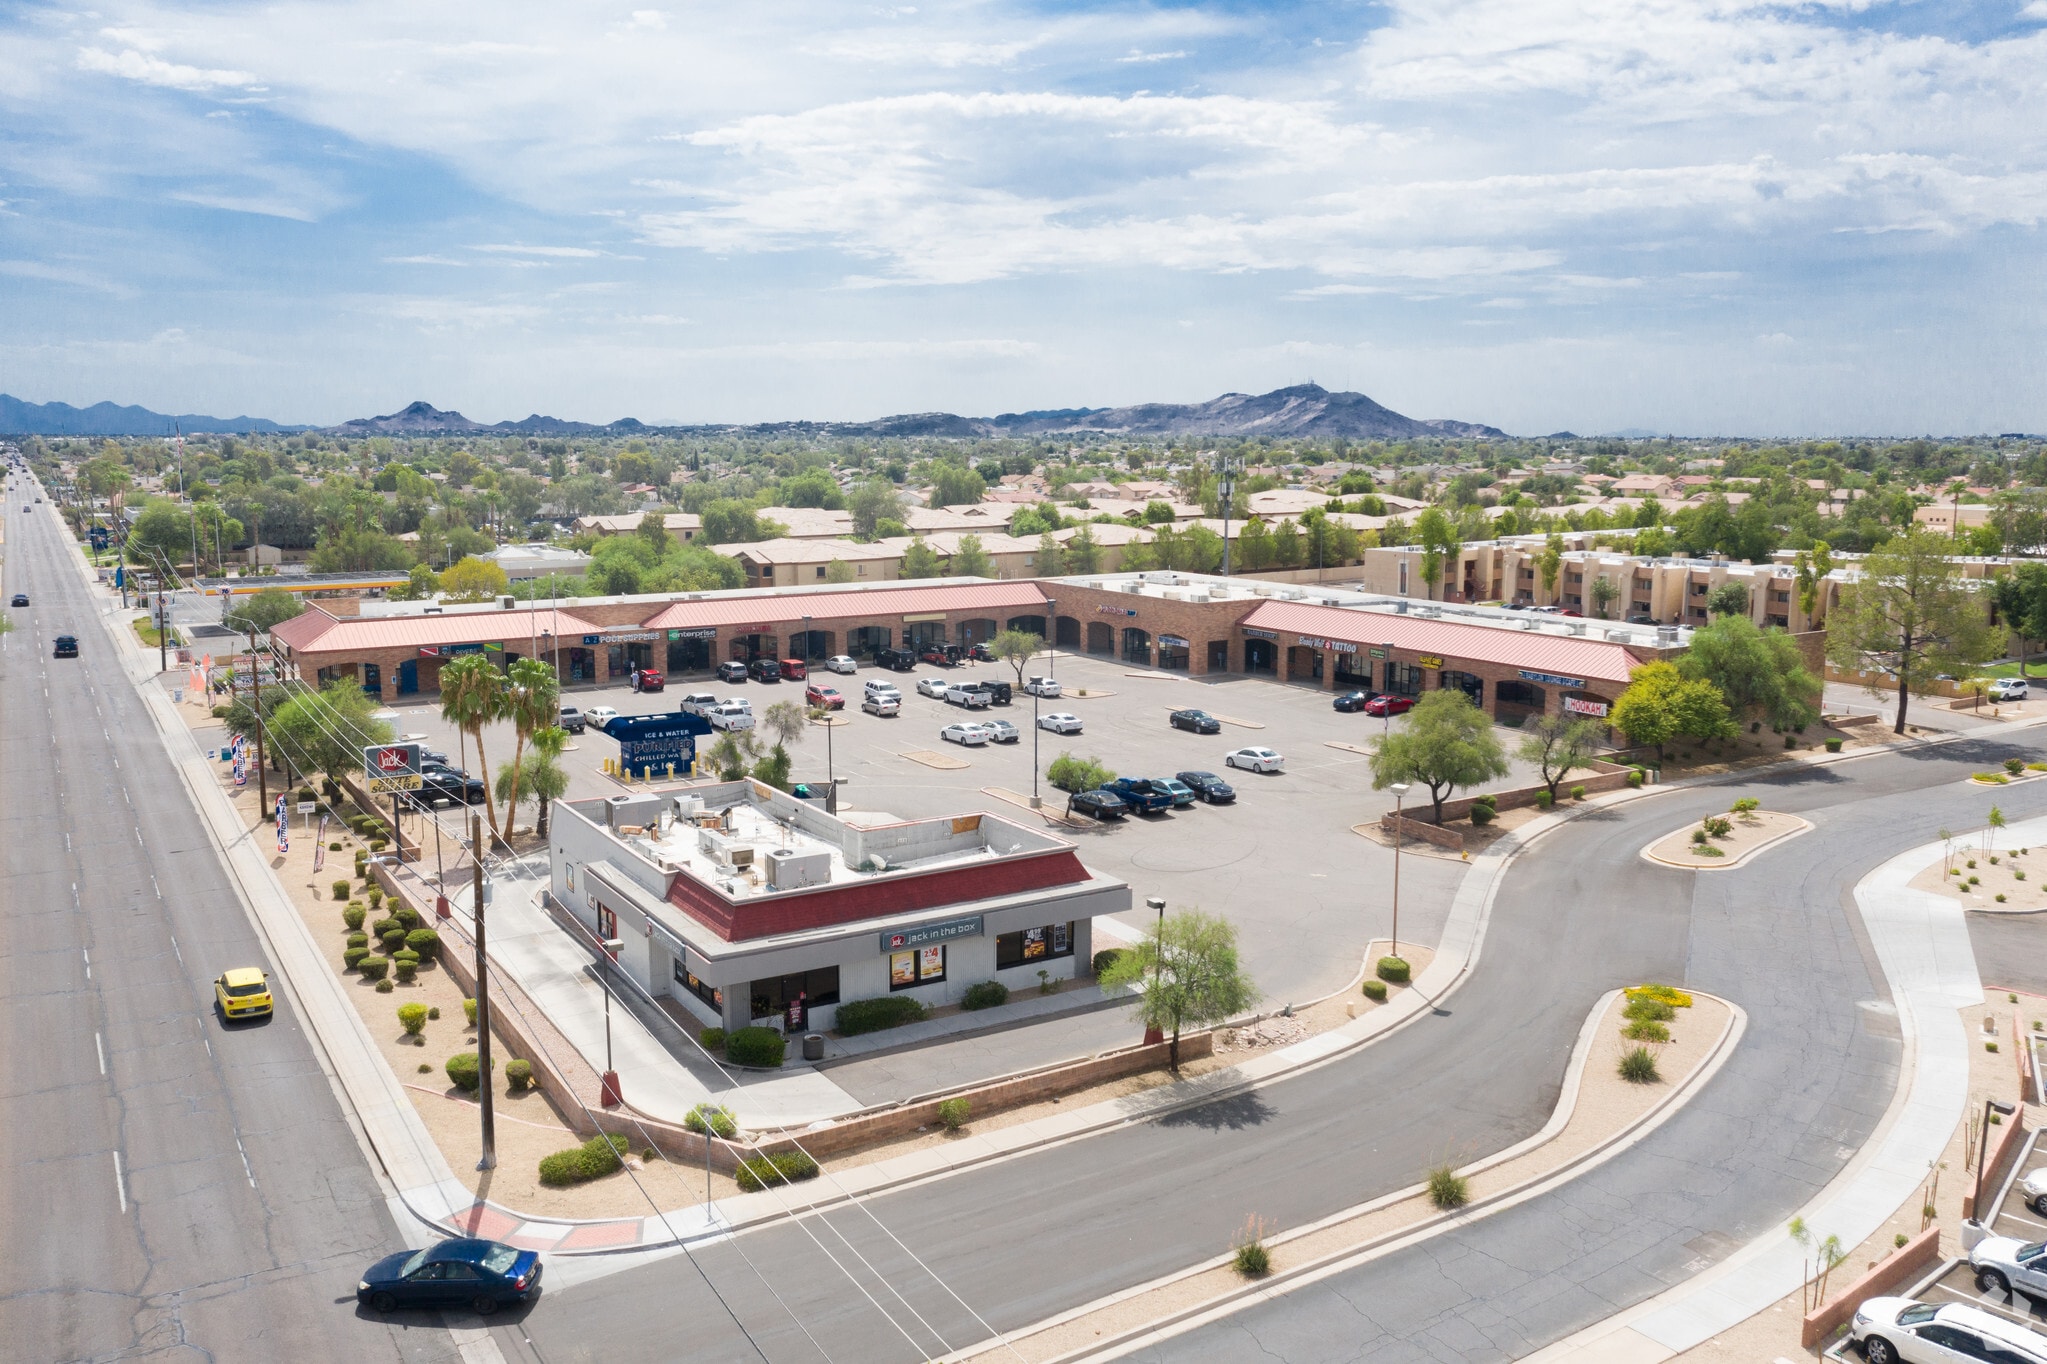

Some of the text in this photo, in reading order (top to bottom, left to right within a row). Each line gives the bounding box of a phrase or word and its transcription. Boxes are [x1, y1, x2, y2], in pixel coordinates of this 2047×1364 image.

[600, 633, 622, 643] POOL
[623, 632, 660, 641] SUPPLIES
[671, 629, 716, 638] enterprise
[1331, 642, 1357, 653] TATTOO
[1570, 700, 1602, 715] HOOKAH
[666, 729, 690, 737] WATER
[634, 740, 693, 753] PURIFIED
[907, 932, 928, 944] jack
[930, 930, 939, 938] in
[940, 927, 957, 936] the
[958, 923, 976, 932] box
